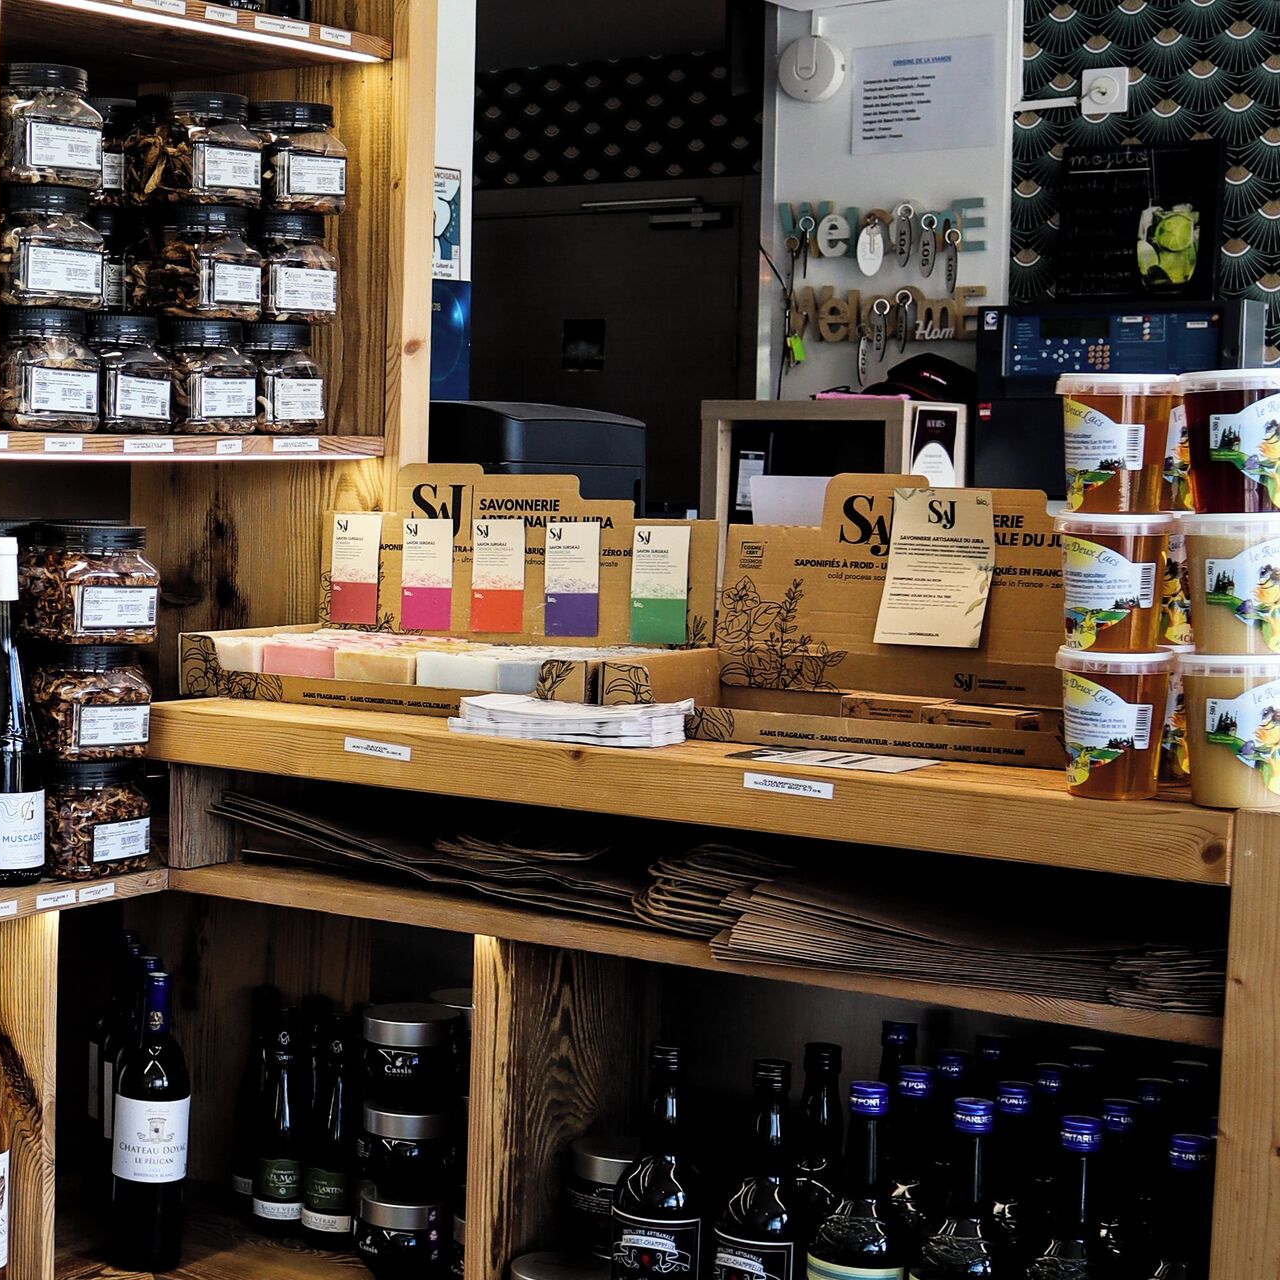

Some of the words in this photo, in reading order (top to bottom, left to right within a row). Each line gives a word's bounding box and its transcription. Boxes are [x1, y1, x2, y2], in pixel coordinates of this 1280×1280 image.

[1070, 146, 1149, 170] mojito
[898, 229, 907, 257] 104
[921, 239, 931, 268] 105
[1082, 411, 1105, 428] Lacs
[479, 498, 560, 513] SAVONNERIE
[899, 534, 931, 542] SAVONNERIE
[931, 535, 963, 544] ARTISANALE
[1023, 533, 1044, 547] DU
[602, 547, 622, 557] ZÉRO
[1071, 541, 1097, 559] Deux
[1096, 550, 1121, 567] Lacs
[794, 557, 841, 568] SAPONIFIÉS
[841, 557, 849, 568] À
[850, 560, 874, 570] FROID
[827, 571, 843, 580] cold
[1020, 568, 1031, 577] EN
[1017, 580, 1043, 589] France
[1070, 678, 1093, 696] Deux
[1092, 688, 1116, 707] Lacs
[302, 691, 316, 699] SANS
[317, 692, 346, 702] FRAGRANCE
[349, 695, 364, 703] SANS
[407, 700, 422, 708] SANS
[422, 701, 451, 710] COLORANT
[759, 729, 777, 738] SANS
[777, 730, 816, 741] FRAGRANCE
[819, 734, 838, 743] SANS
[838, 735, 888, 746] CONSERVATEUR
[892, 739, 911, 748] SANS
[911, 740, 949, 751] COLORANT
[952, 743, 971, 753] SANS
[1, 832, 44, 844] MUSCADET
[384, 1063, 413, 1076] Cassis
[119, 1141, 159, 1155] CHATEAU
[134, 1156, 143, 1165] LE
